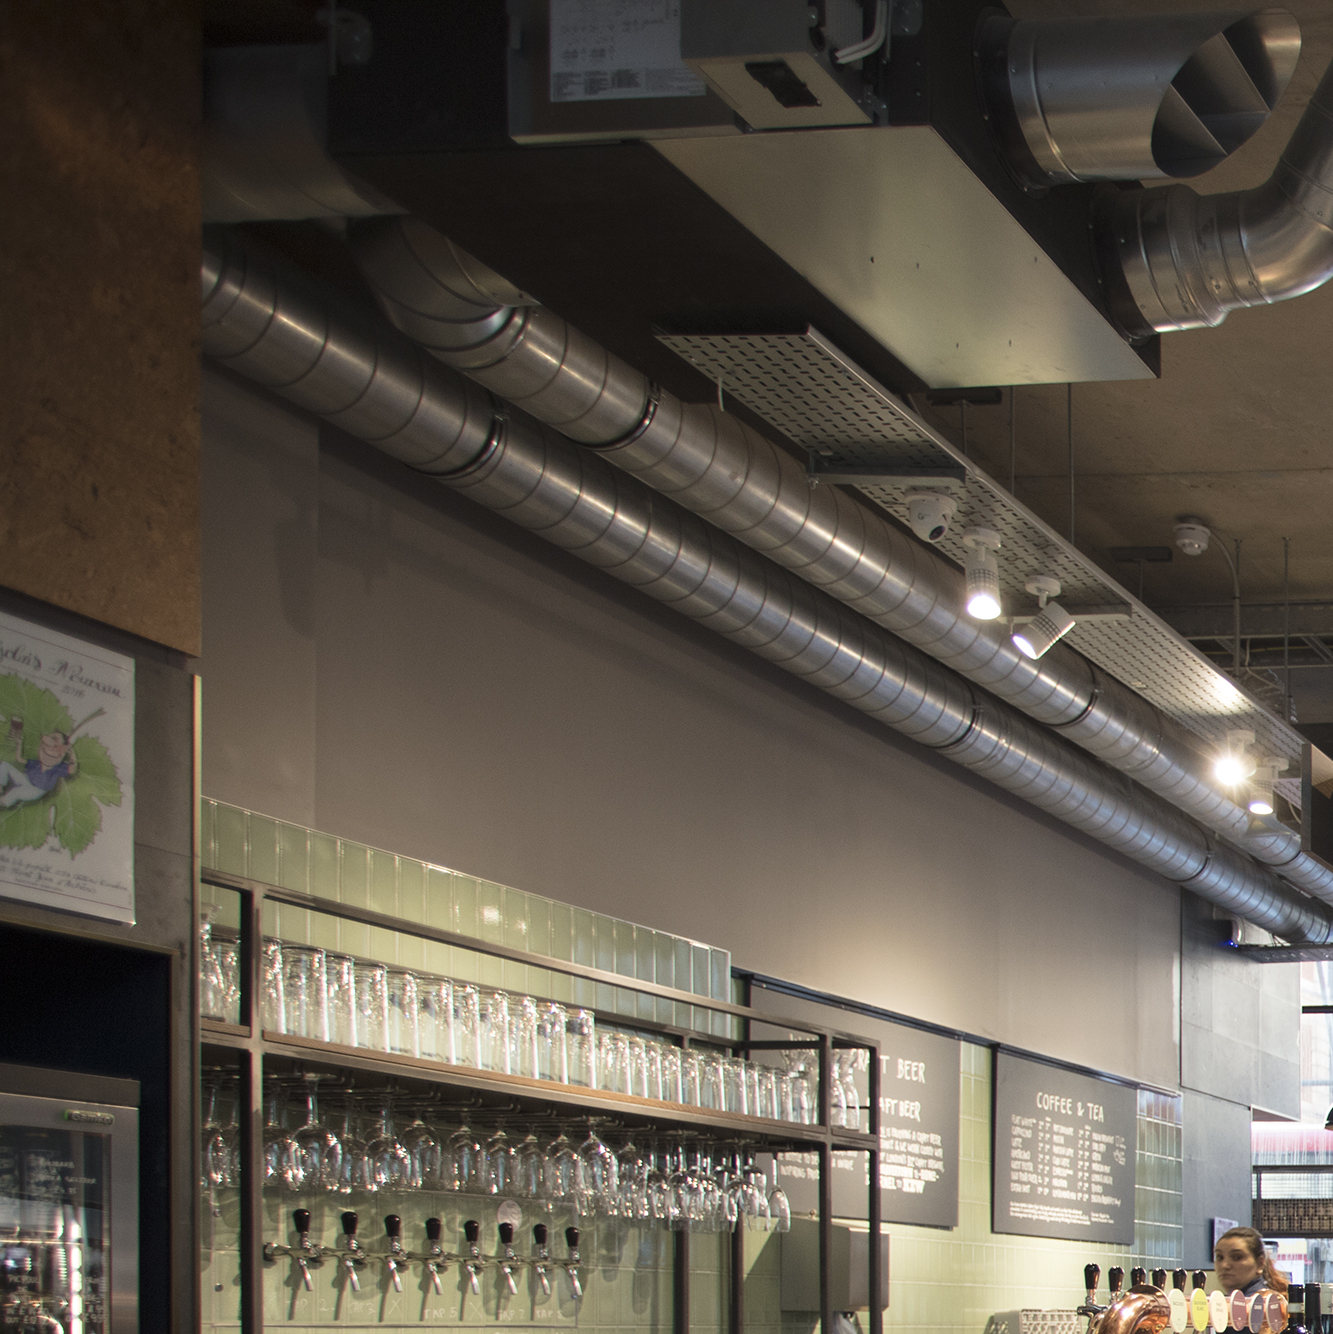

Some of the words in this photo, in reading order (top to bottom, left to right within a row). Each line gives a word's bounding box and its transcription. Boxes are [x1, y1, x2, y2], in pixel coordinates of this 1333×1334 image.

[897, 1058, 926, 1084] BEER
[898, 1100, 921, 1123] BEER
[1036, 1091, 1073, 1115] COFFEE
[1077, 1101, 1085, 1117] &
[1087, 1102, 1105, 1123] TEA
[449, 1306, 458, 1319] 5
